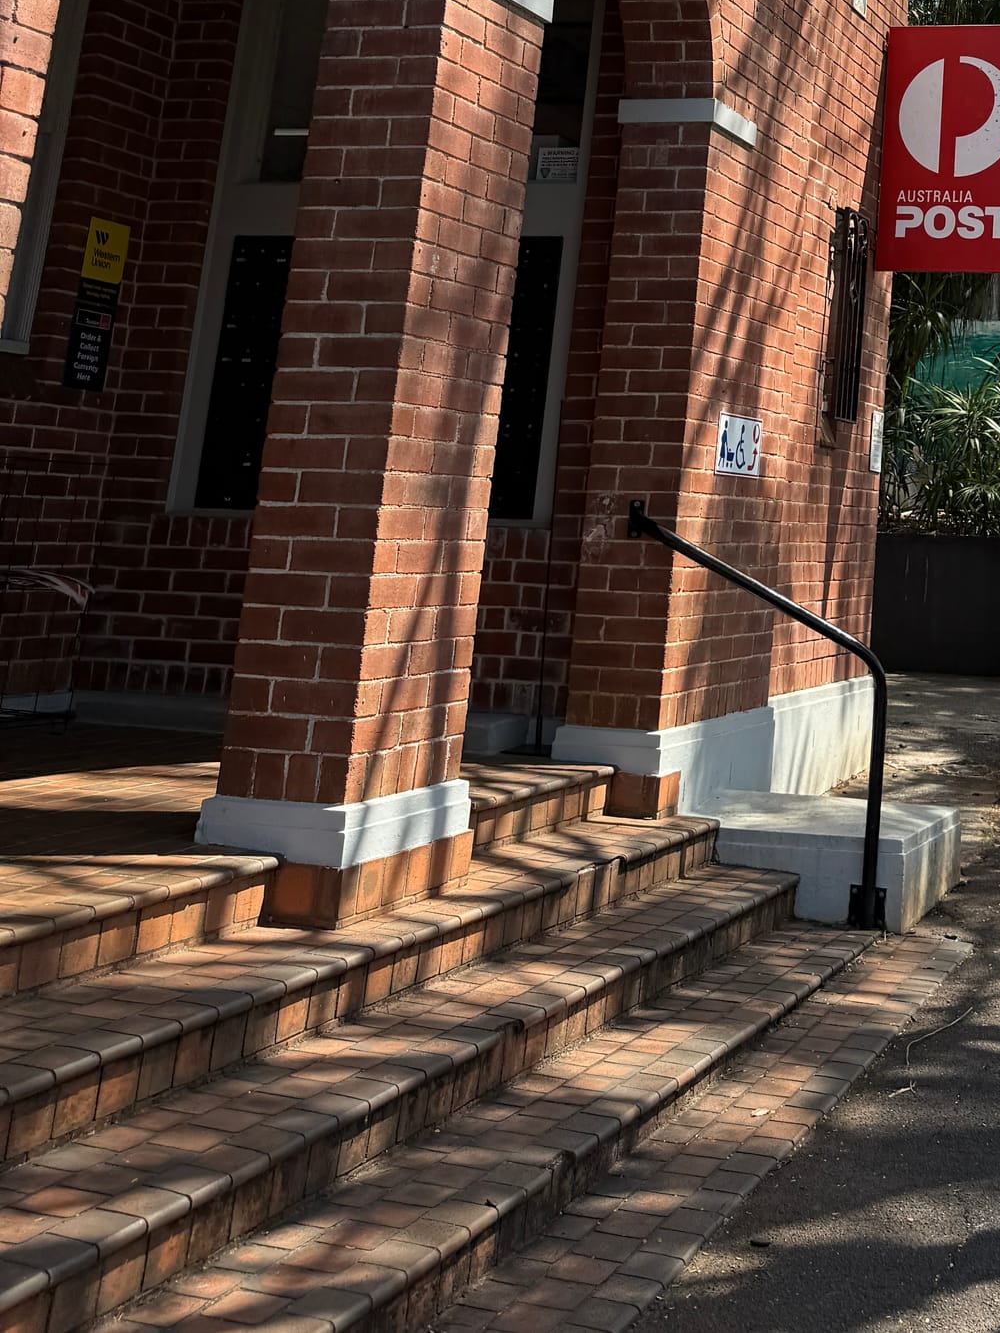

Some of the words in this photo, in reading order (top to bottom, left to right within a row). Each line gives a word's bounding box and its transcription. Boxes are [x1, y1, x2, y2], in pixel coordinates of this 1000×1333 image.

[896, 189, 974, 203] AUSTRALIA
[94, 247, 121, 262] Western
[91, 255, 112, 270] Union
[80, 331, 97, 342] Order
[76, 371, 92, 382] Here
